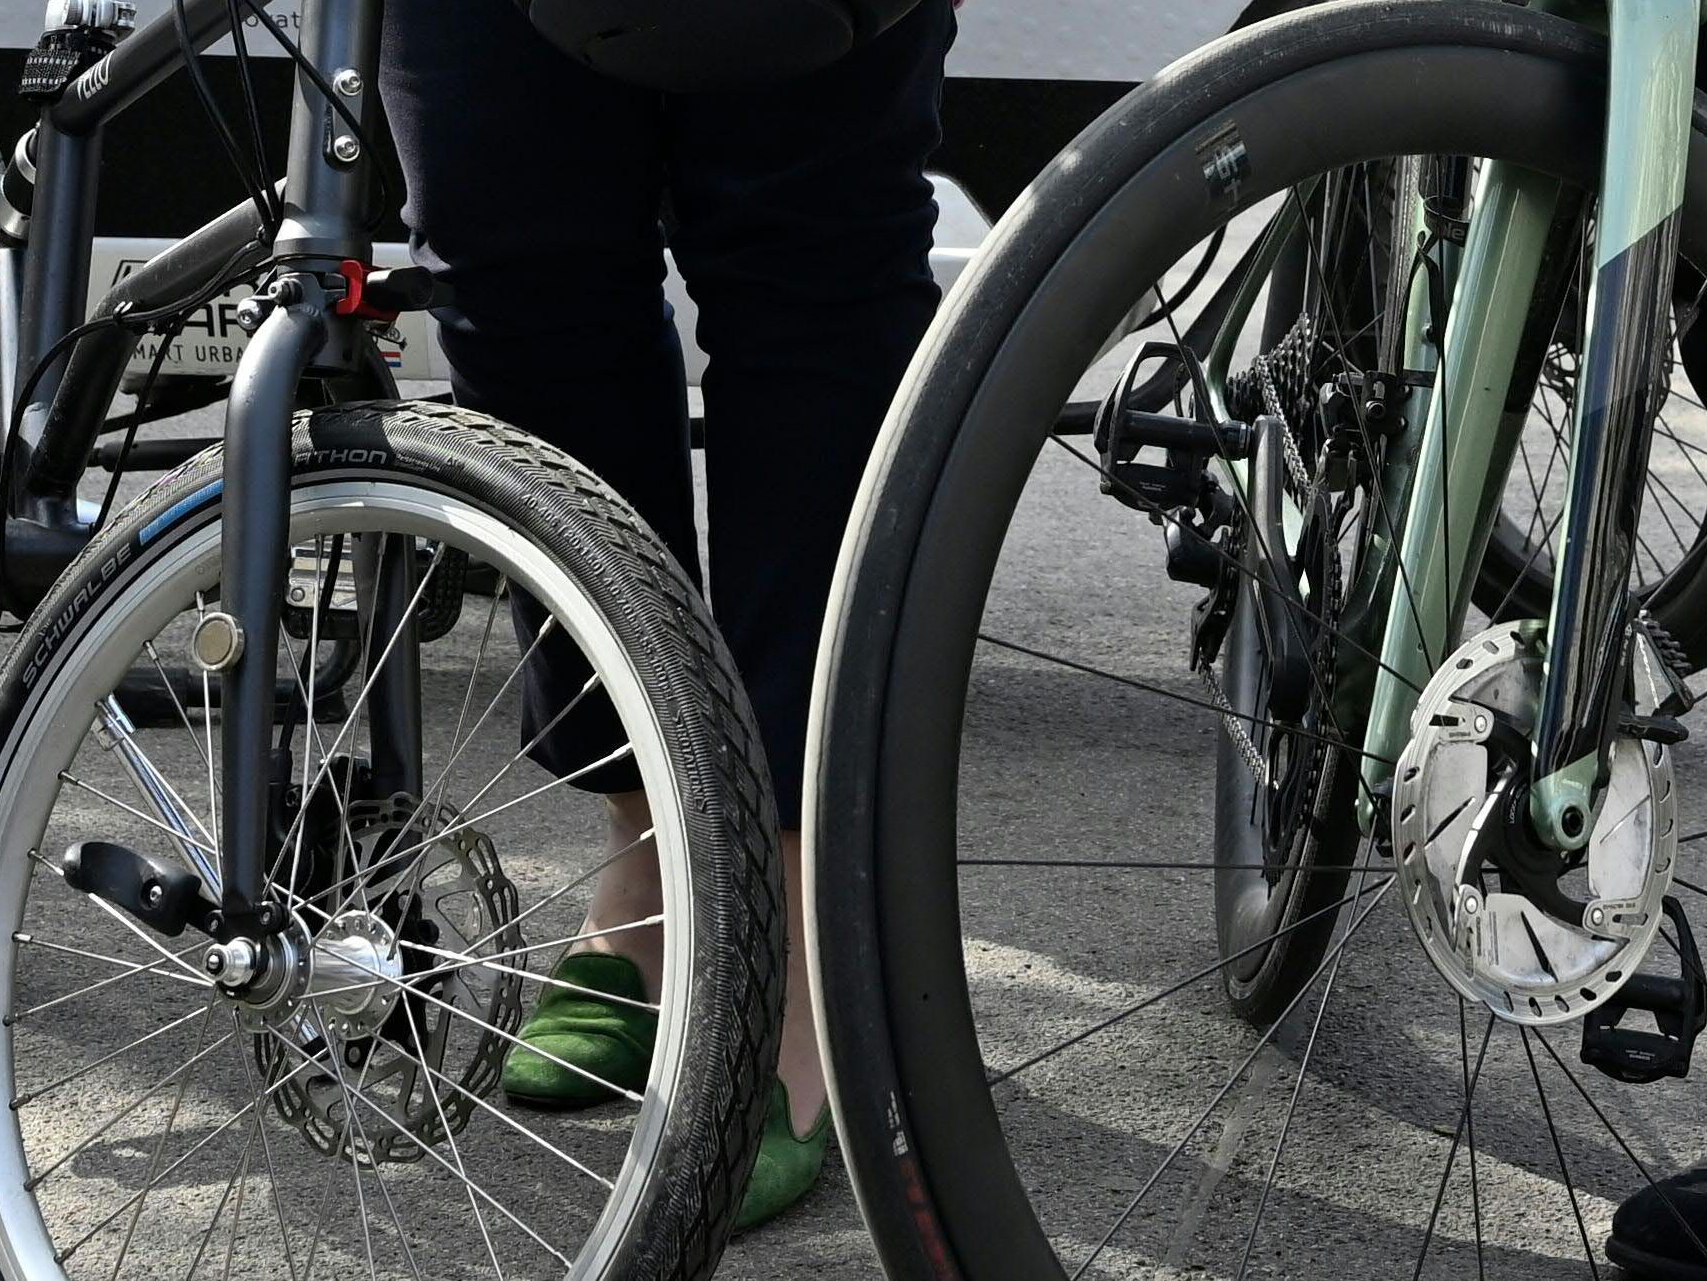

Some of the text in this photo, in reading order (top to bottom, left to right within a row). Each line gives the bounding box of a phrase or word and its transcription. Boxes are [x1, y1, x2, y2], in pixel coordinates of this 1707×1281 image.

[132, 344, 183, 363] MART
[293, 448, 388, 467] ATHON
[22, 542, 133, 690] SCHWALBE
